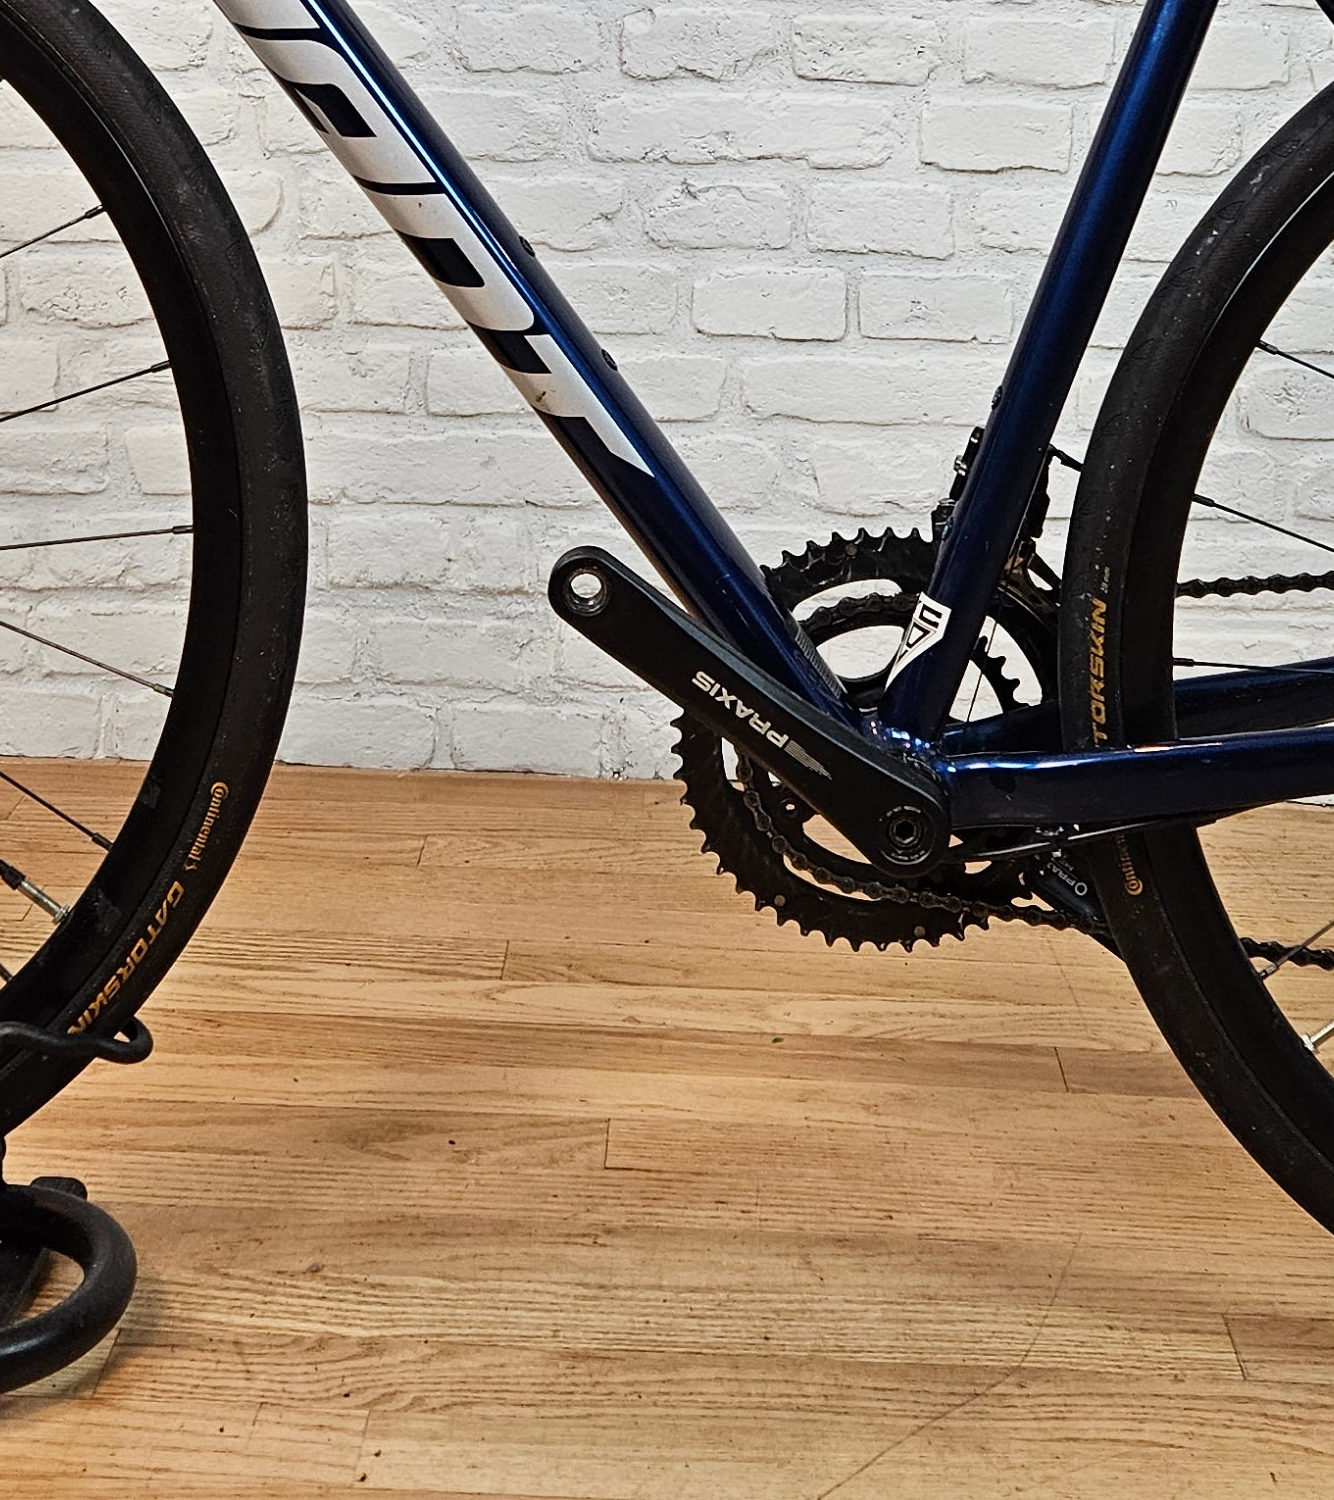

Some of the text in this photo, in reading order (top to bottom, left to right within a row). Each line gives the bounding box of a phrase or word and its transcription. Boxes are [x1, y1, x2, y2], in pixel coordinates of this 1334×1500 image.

[691, 670, 789, 749] PRAXIS
[1089, 597, 1108, 748] TORSKIN
[187, 781, 229, 862] Continental
[67, 880, 185, 1035] GATORSKIN
